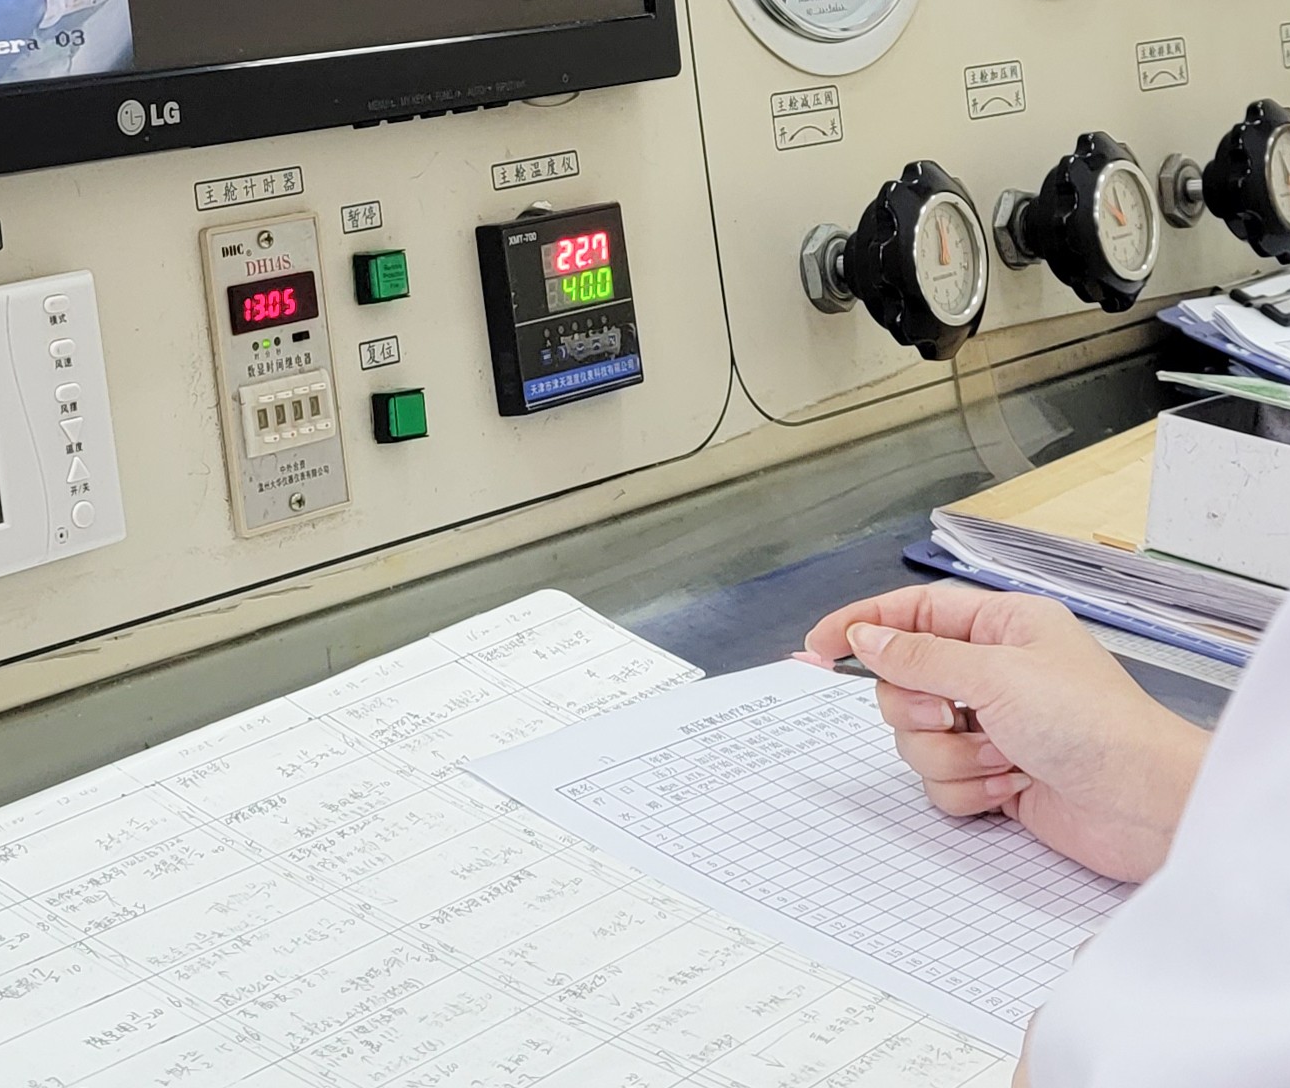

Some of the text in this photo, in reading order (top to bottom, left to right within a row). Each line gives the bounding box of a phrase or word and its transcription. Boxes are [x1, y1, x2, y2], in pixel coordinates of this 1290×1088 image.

[55, 28, 85, 49] 03
[970, 65, 1019, 85] 主舱加压阀
[777, 90, 834, 112] 主舱减压阀
[149, 100, 181, 126] LG
[778, 119, 839, 145] 开 关
[499, 156, 574, 185] 主舱温度仪
[204, 172, 296, 206] 主舱计时器
[347, 206, 376, 228] 暂停
[508, 232, 537, 246] XMT-700
[557, 232, 608, 271] 22.7
[245, 254, 292, 276] DH14S
[563, 267, 612, 302] 40.0
[50, 314, 67, 326] 模式
[366, 343, 395, 365] 复位
[55, 357, 73, 369] 风速
[247, 353, 312, 378] 数显时间继电器
[66, 442, 83, 455] 温度
[70, 483, 90, 497] 开/关
[656, 833, 668, 842] 2
[672, 842, 685, 851] 3
[690, 852, 702, 860] 4
[706, 861, 718, 869] 5
[723, 869, 736, 878] 6
[740, 878, 752, 887] 7
[758, 887, 771, 896] 8
[776, 896, 789, 905] 9
[792, 904, 810, 913] 10
[810, 913, 828, 922] 11
[829, 920, 847, 931] 12
[848, 930, 866, 941] 13
[867, 940, 886, 950] 14
[885, 948, 904, 959] 15
[905, 958, 923, 968] 16
[925, 967, 942, 977] 17
[945, 976, 963, 987] 18
[964, 986, 983, 997] 19
[985, 996, 1004, 1007] 20
[1005, 1007, 1024, 1018] 21
